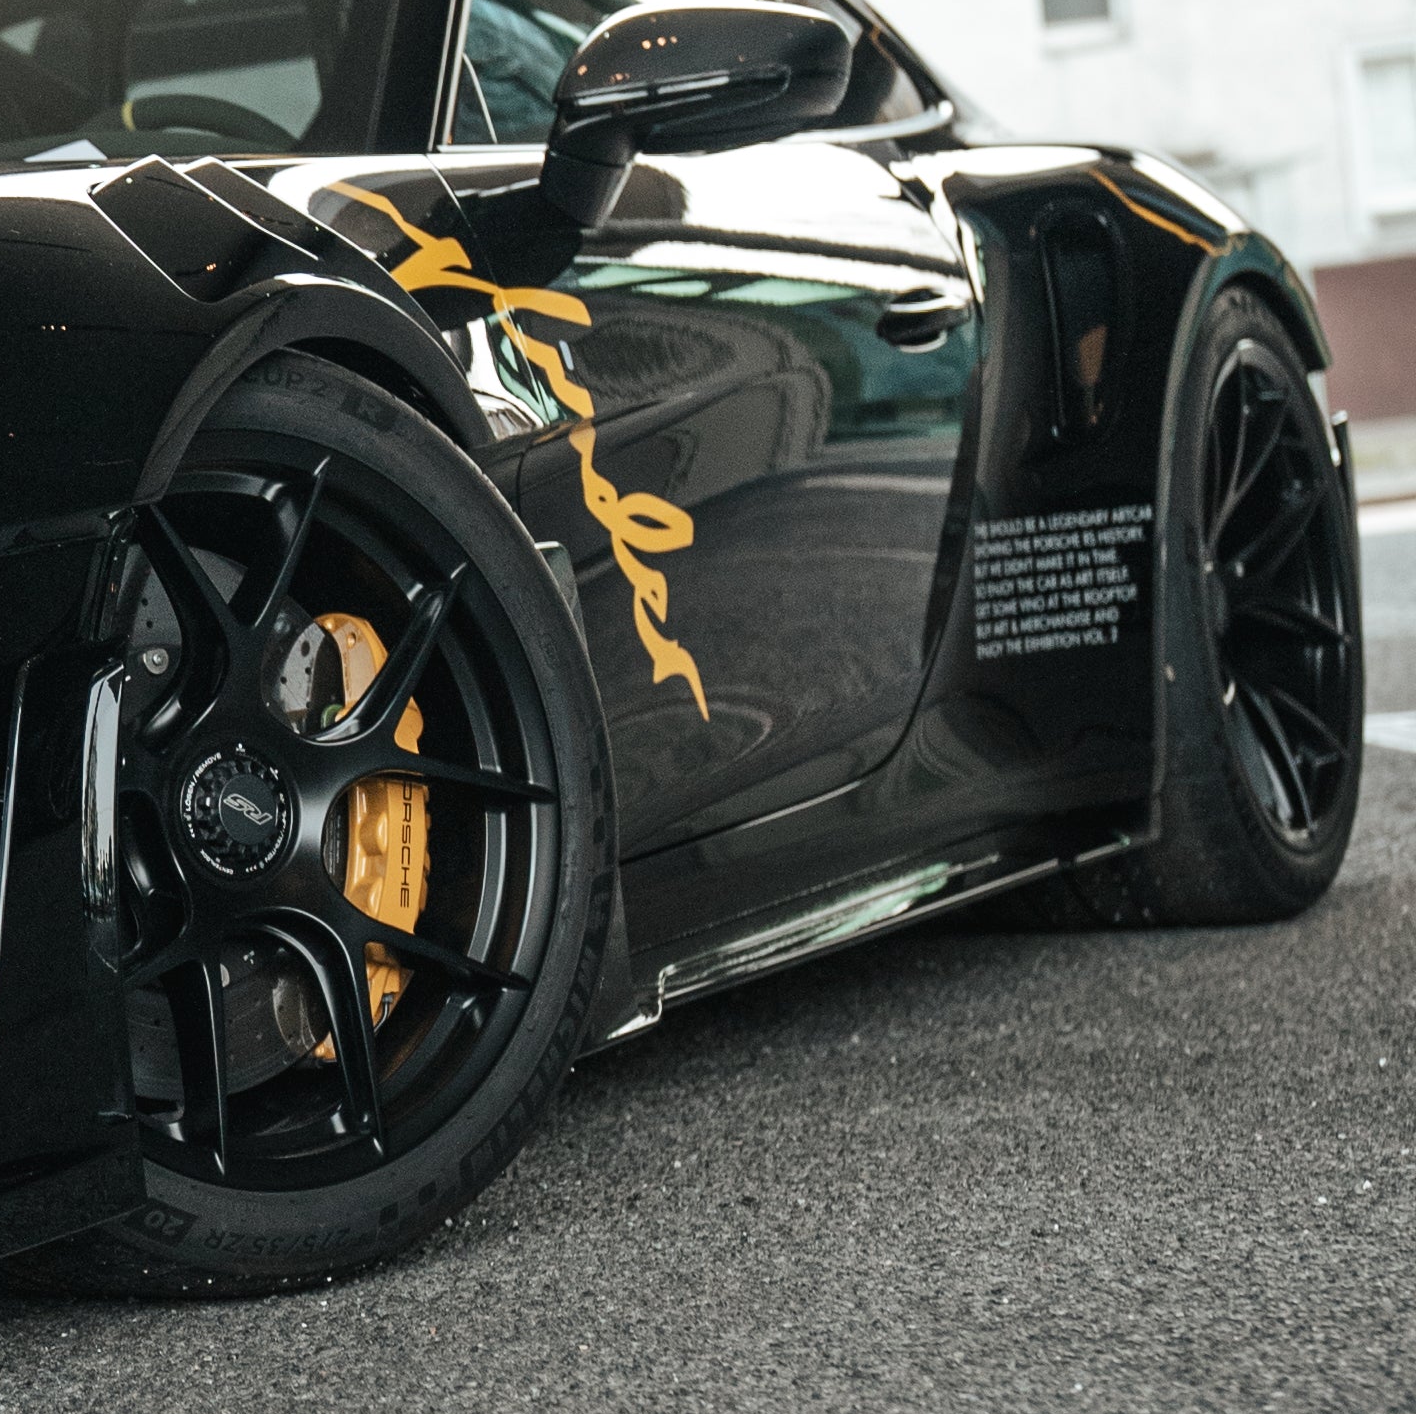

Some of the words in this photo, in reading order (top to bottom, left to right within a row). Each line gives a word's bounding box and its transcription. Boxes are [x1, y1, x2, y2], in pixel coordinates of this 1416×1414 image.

[1033, 532, 1081, 552] PORSCHE
[1016, 578, 1034, 593] THE
[1036, 574, 1057, 590] CAR
[1061, 590, 1081, 606] THE
[1020, 608, 1092, 633] MERCHANDISE
[1024, 632, 1081, 653] EXHIBITION
[194, 751, 222, 778] REMOVE
[400, 780, 412, 908] ORSCHE
